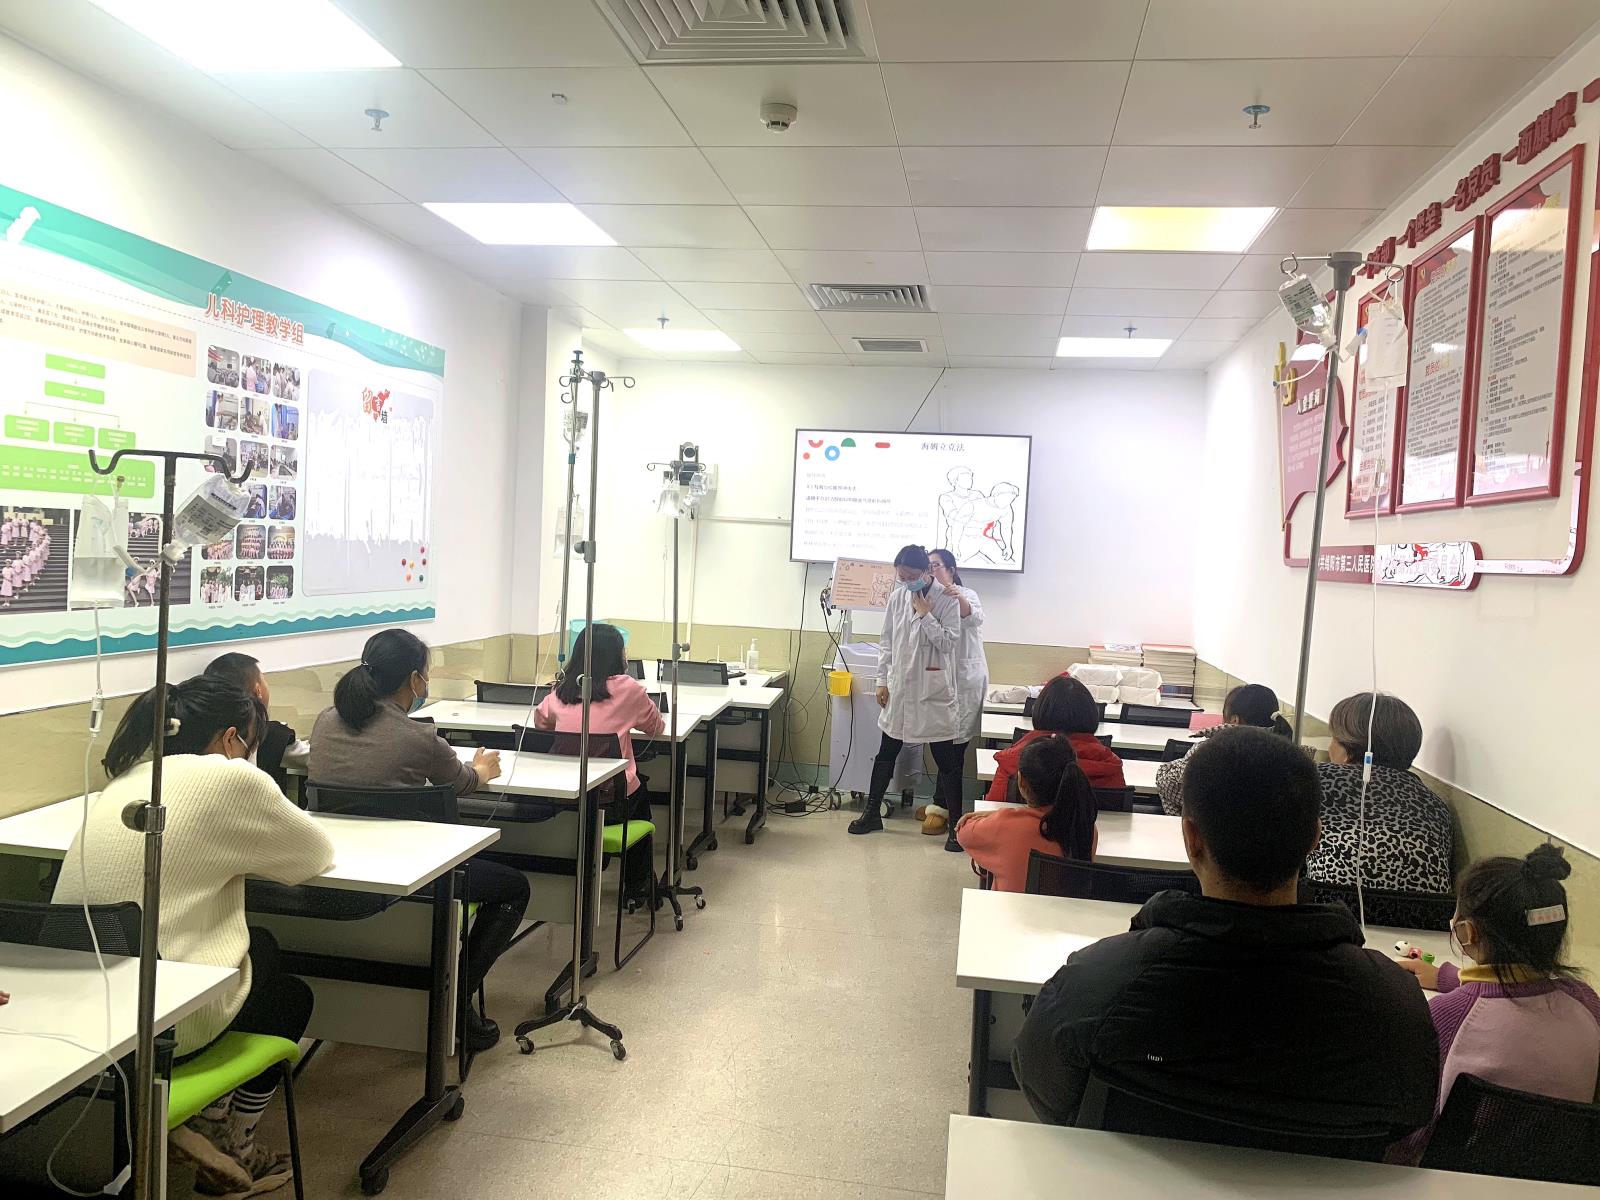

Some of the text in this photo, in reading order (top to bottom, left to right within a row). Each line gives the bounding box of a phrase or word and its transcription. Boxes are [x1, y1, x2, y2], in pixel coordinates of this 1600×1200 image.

[206, 293, 305, 347] 儿科护理教学组
